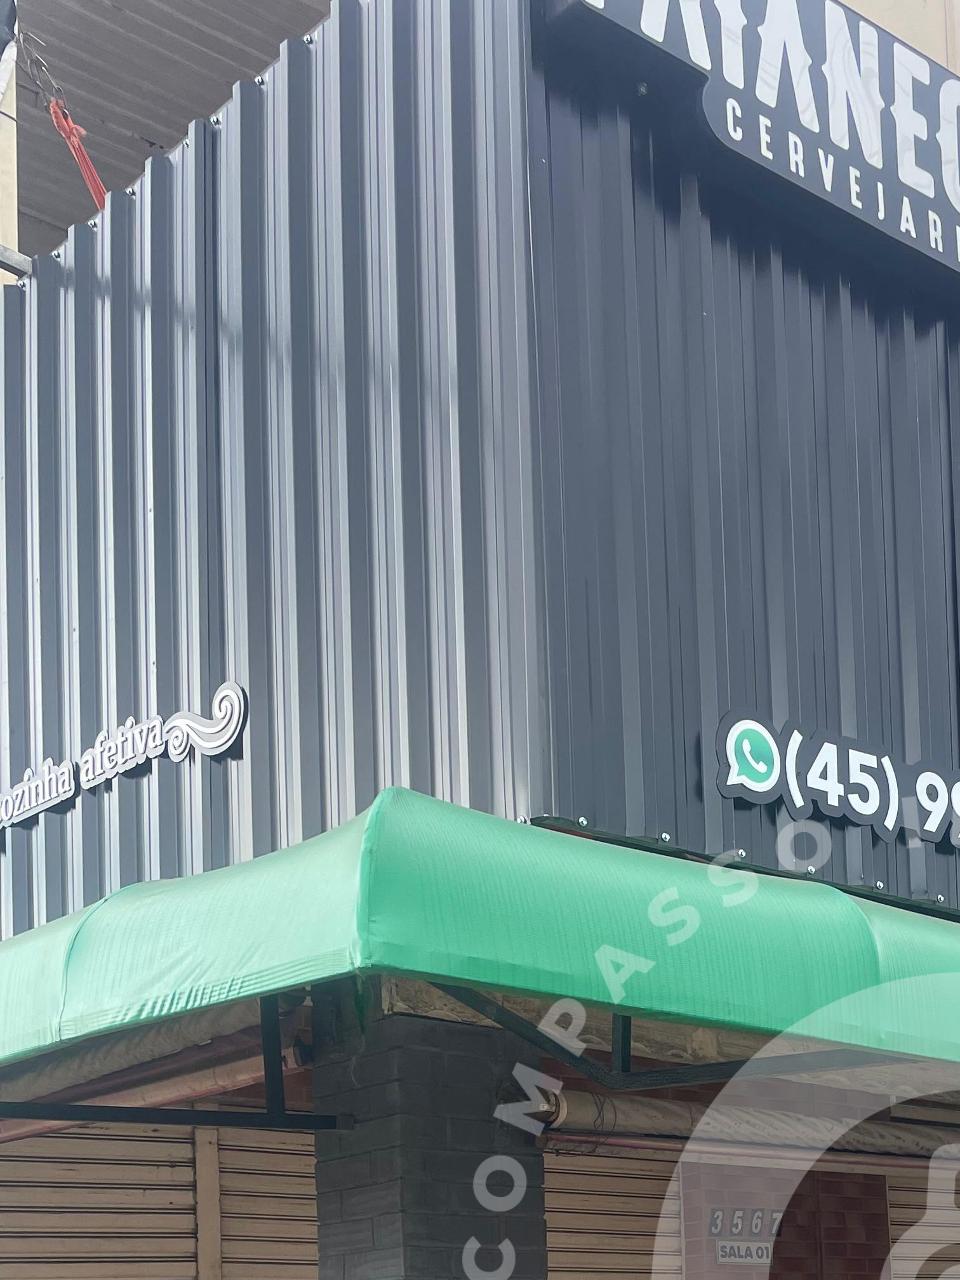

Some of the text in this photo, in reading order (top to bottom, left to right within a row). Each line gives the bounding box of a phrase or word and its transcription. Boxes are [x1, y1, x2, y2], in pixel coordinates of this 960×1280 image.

[0, 719, 163, 821] ozinha afetiva
[786, 729, 898, 831] (45)
[711, 1209, 784, 1235] 3567
[720, 1245, 770, 1259] SALA 01
